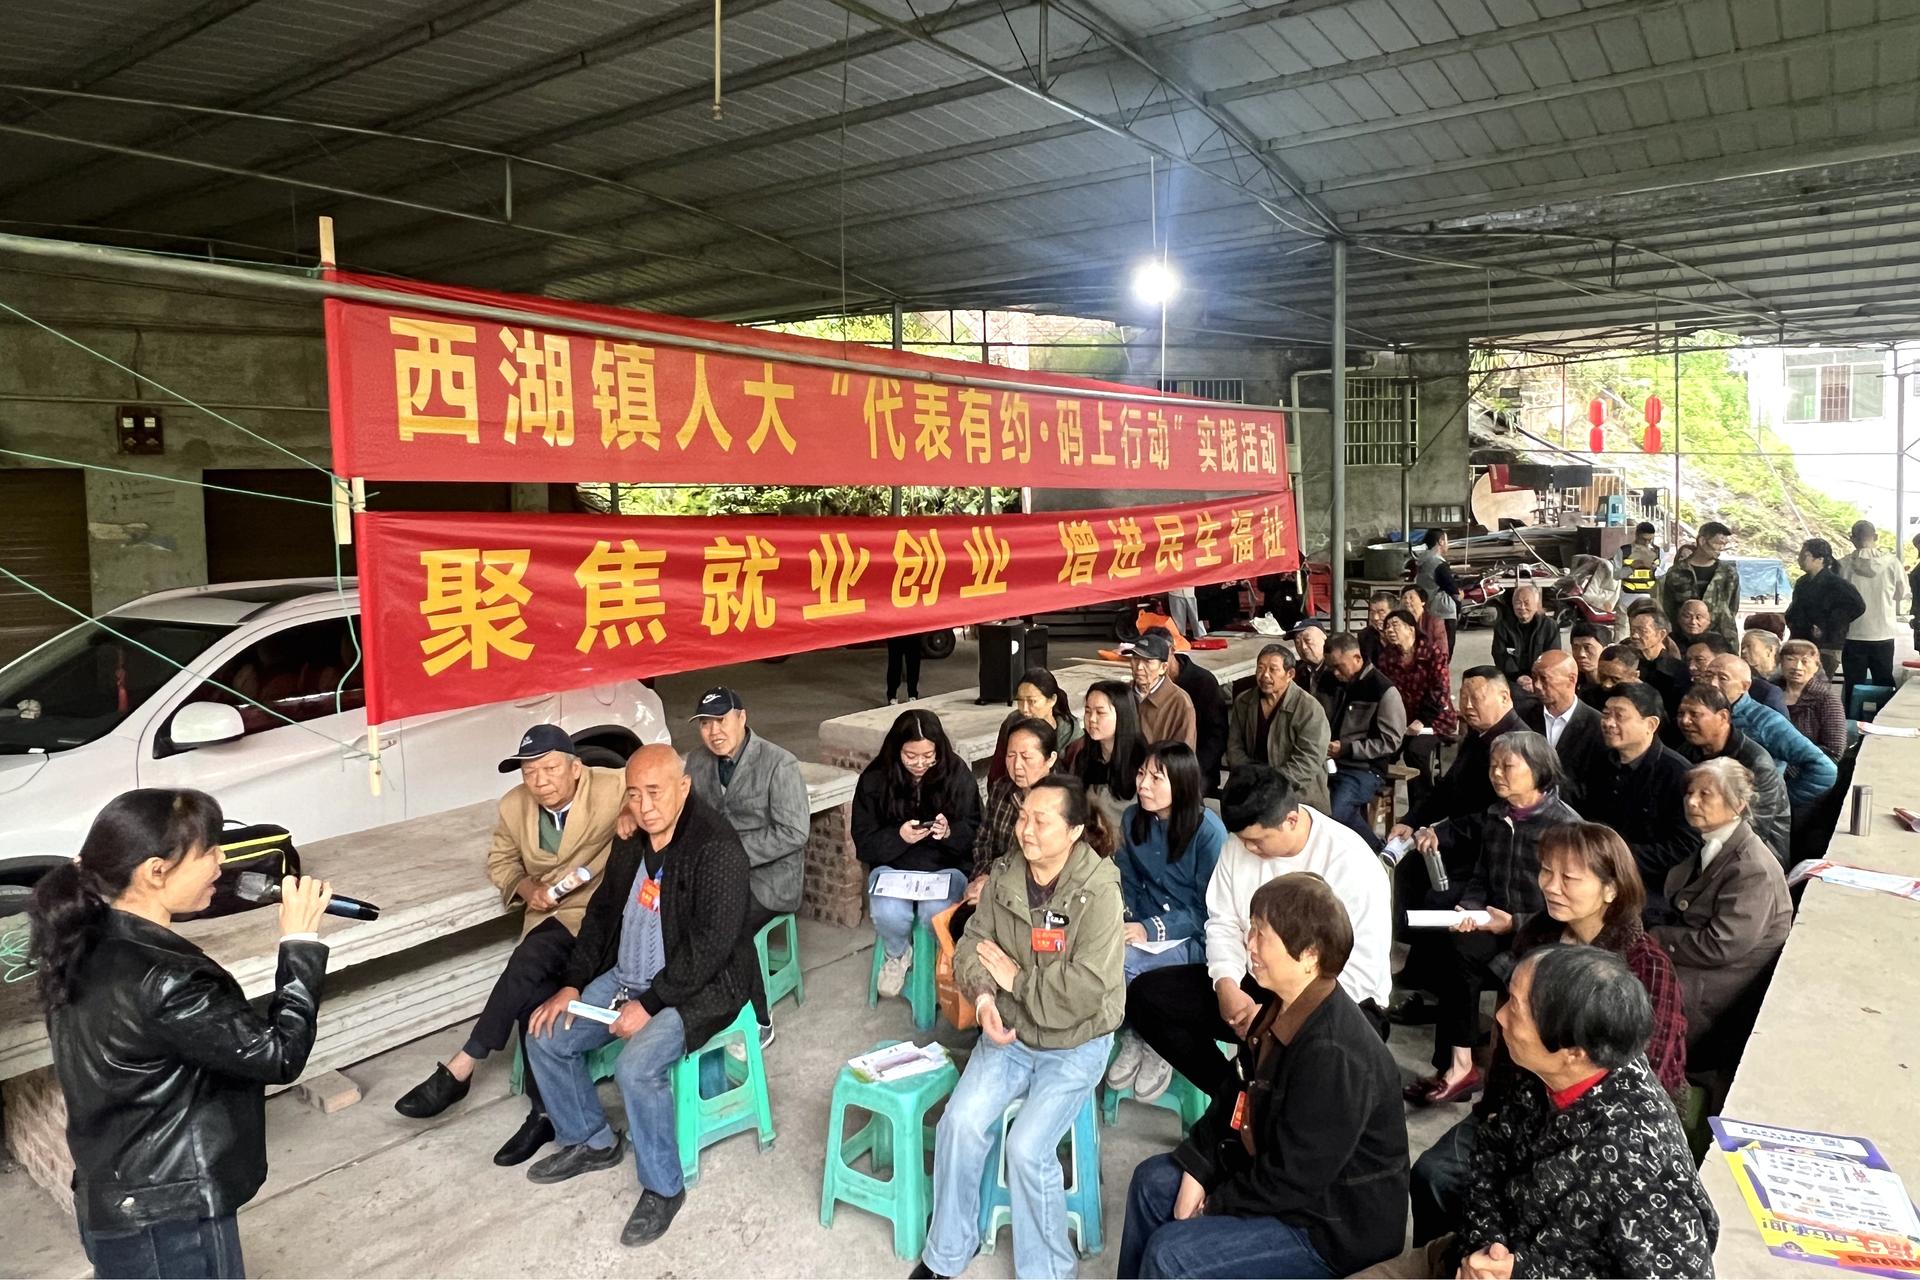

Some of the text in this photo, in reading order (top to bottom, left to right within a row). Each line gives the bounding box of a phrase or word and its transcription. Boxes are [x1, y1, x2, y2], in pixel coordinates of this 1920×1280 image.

[419, 504, 1287, 677] 聚焦就业创业 增进民生福祉
